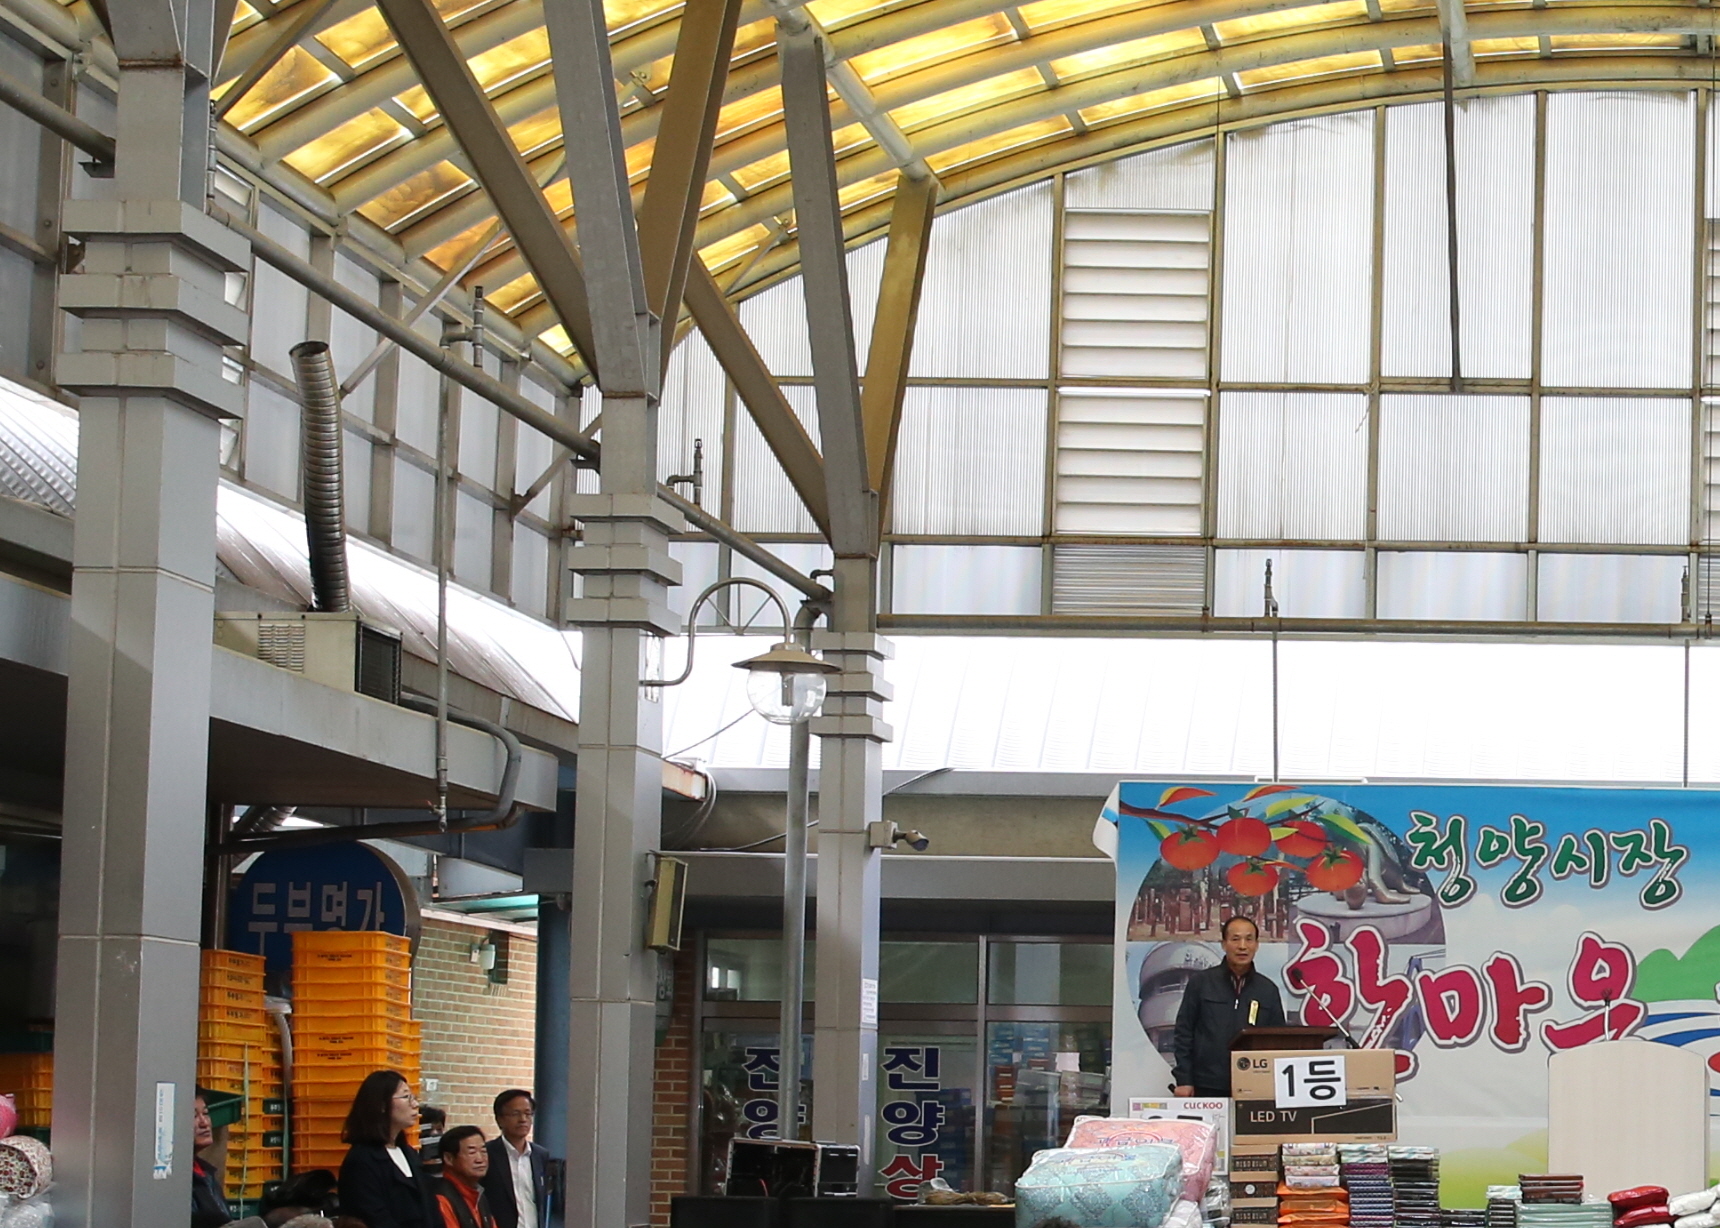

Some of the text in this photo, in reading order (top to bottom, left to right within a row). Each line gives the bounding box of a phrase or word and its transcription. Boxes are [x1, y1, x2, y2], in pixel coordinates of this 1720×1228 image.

[1406, 811, 1688, 906] 청양시장
[1253, 1059, 1268, 1069] LG
[1282, 1060, 1341, 1100] 1등
[1183, 1101, 1223, 1110] CUCKOO
[1250, 1111, 1297, 1123] LED TV
